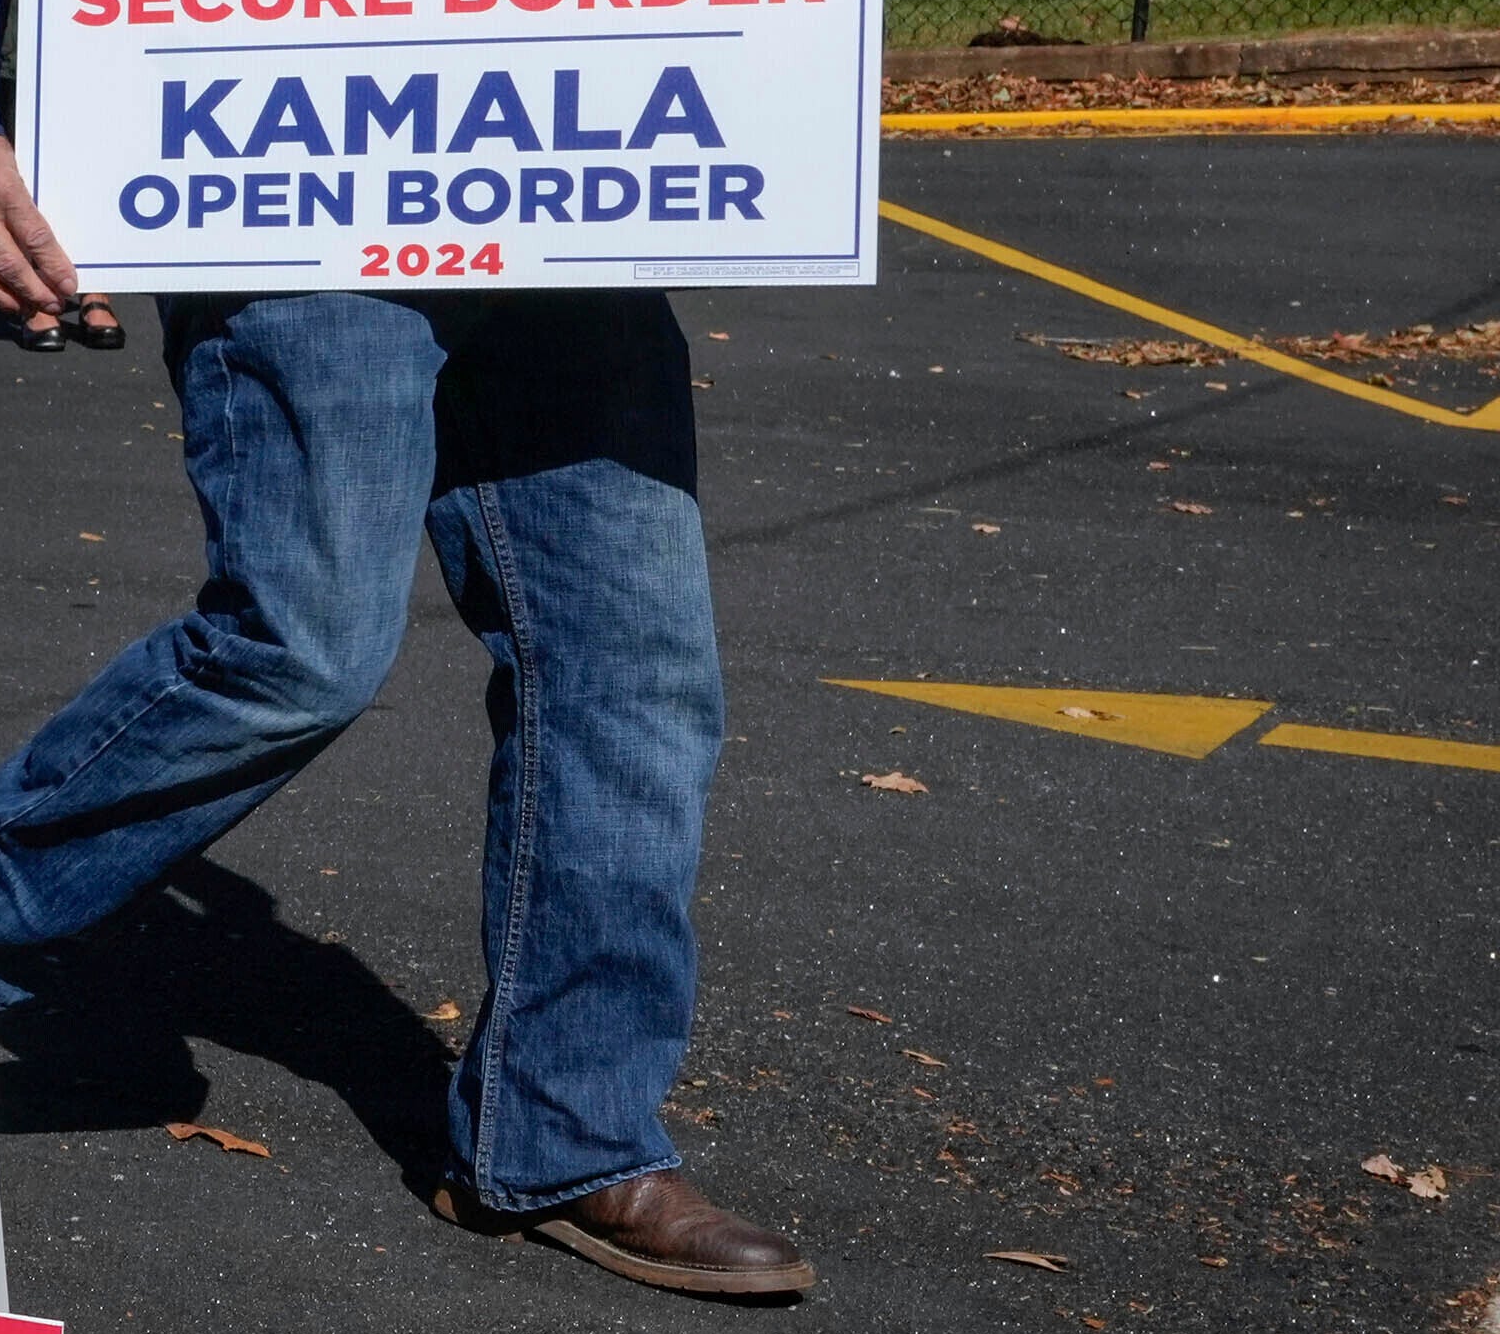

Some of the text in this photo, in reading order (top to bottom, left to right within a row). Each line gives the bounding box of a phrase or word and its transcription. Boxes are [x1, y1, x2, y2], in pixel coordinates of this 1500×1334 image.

[162, 66, 725, 159] KAMALA
[119, 164, 765, 230] OPEN BORDER
[360, 243, 505, 277] 2024
